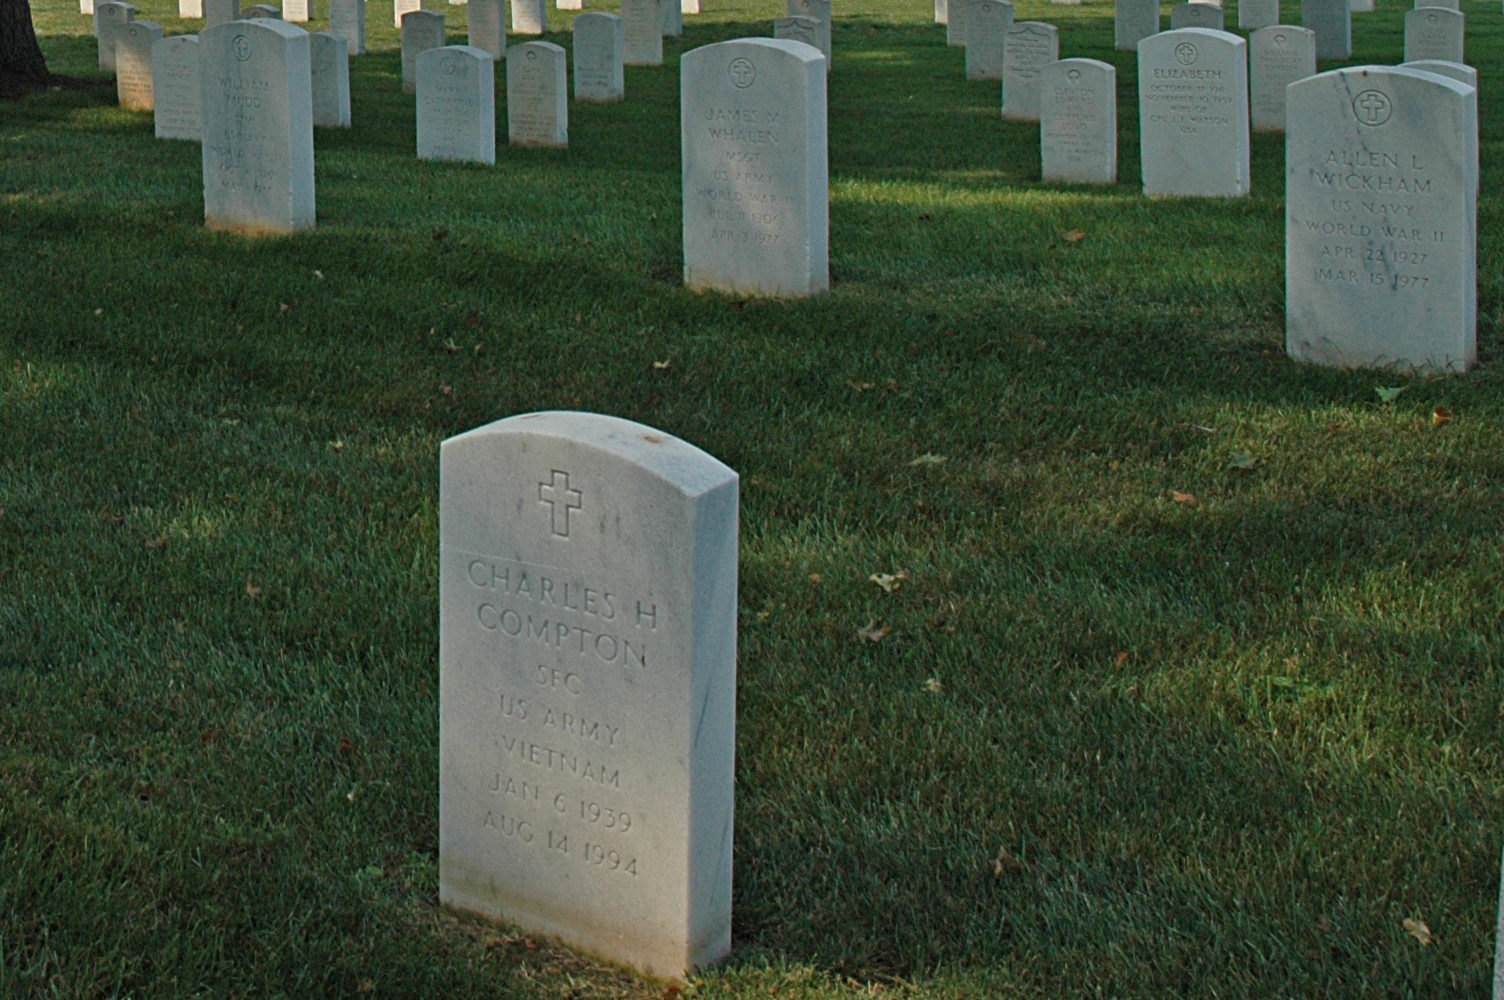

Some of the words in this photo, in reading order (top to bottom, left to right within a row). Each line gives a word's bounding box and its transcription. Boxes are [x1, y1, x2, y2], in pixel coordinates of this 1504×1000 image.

[217, 77, 270, 92] WILLIAM
[1153, 68, 1222, 80] ELIZABETH
[1145, 94, 1194, 103] NOVEMBER
[705, 108, 759, 125] JAMES
[767, 111, 780, 125] M
[1190, 116, 1229, 126] WATSON
[708, 127, 779, 145] WHALEN
[1325, 149, 1398, 168] ALLEN
[1411, 154, 1424, 171] L
[713, 170, 729, 182] US
[736, 172, 775, 184] ARMY
[1315, 171, 1432, 195] WICKHAM
[696, 187, 744, 203] WORLD
[749, 191, 780, 206] WAR
[1331, 199, 1352, 214] US
[1361, 201, 1415, 217] NAVY
[710, 228, 735, 242] APR
[754, 232, 781, 245] 1977
[1305, 220, 1372, 238] WORLD
[1381, 226, 1423, 242] WAR
[1433, 230, 1445, 243] II
[1321, 244, 1355, 261] APR
[1365, 248, 1385, 263] 22
[1393, 250, 1429, 266] 1927
[1319, 268, 1360, 284] MAR
[1369, 272, 1385, 286] 15
[1394, 273, 1430, 289] 1977
[467, 559, 617, 620] CHARLES
[634, 599, 659, 632] H
[476, 602, 648, 669] COMPTON
[536, 664, 582, 696] SFC
[498, 694, 528, 720] US
[543, 707, 620, 747] ARMY
[500, 735, 620, 790] VIETNAM
[488, 773, 539, 802] JAN
[552, 792, 567, 814] 6
[580, 800, 633, 833] 1939
[483, 810, 535, 843] AUG
[546, 830, 570, 855] 14
[584, 842, 640, 878] 1994
